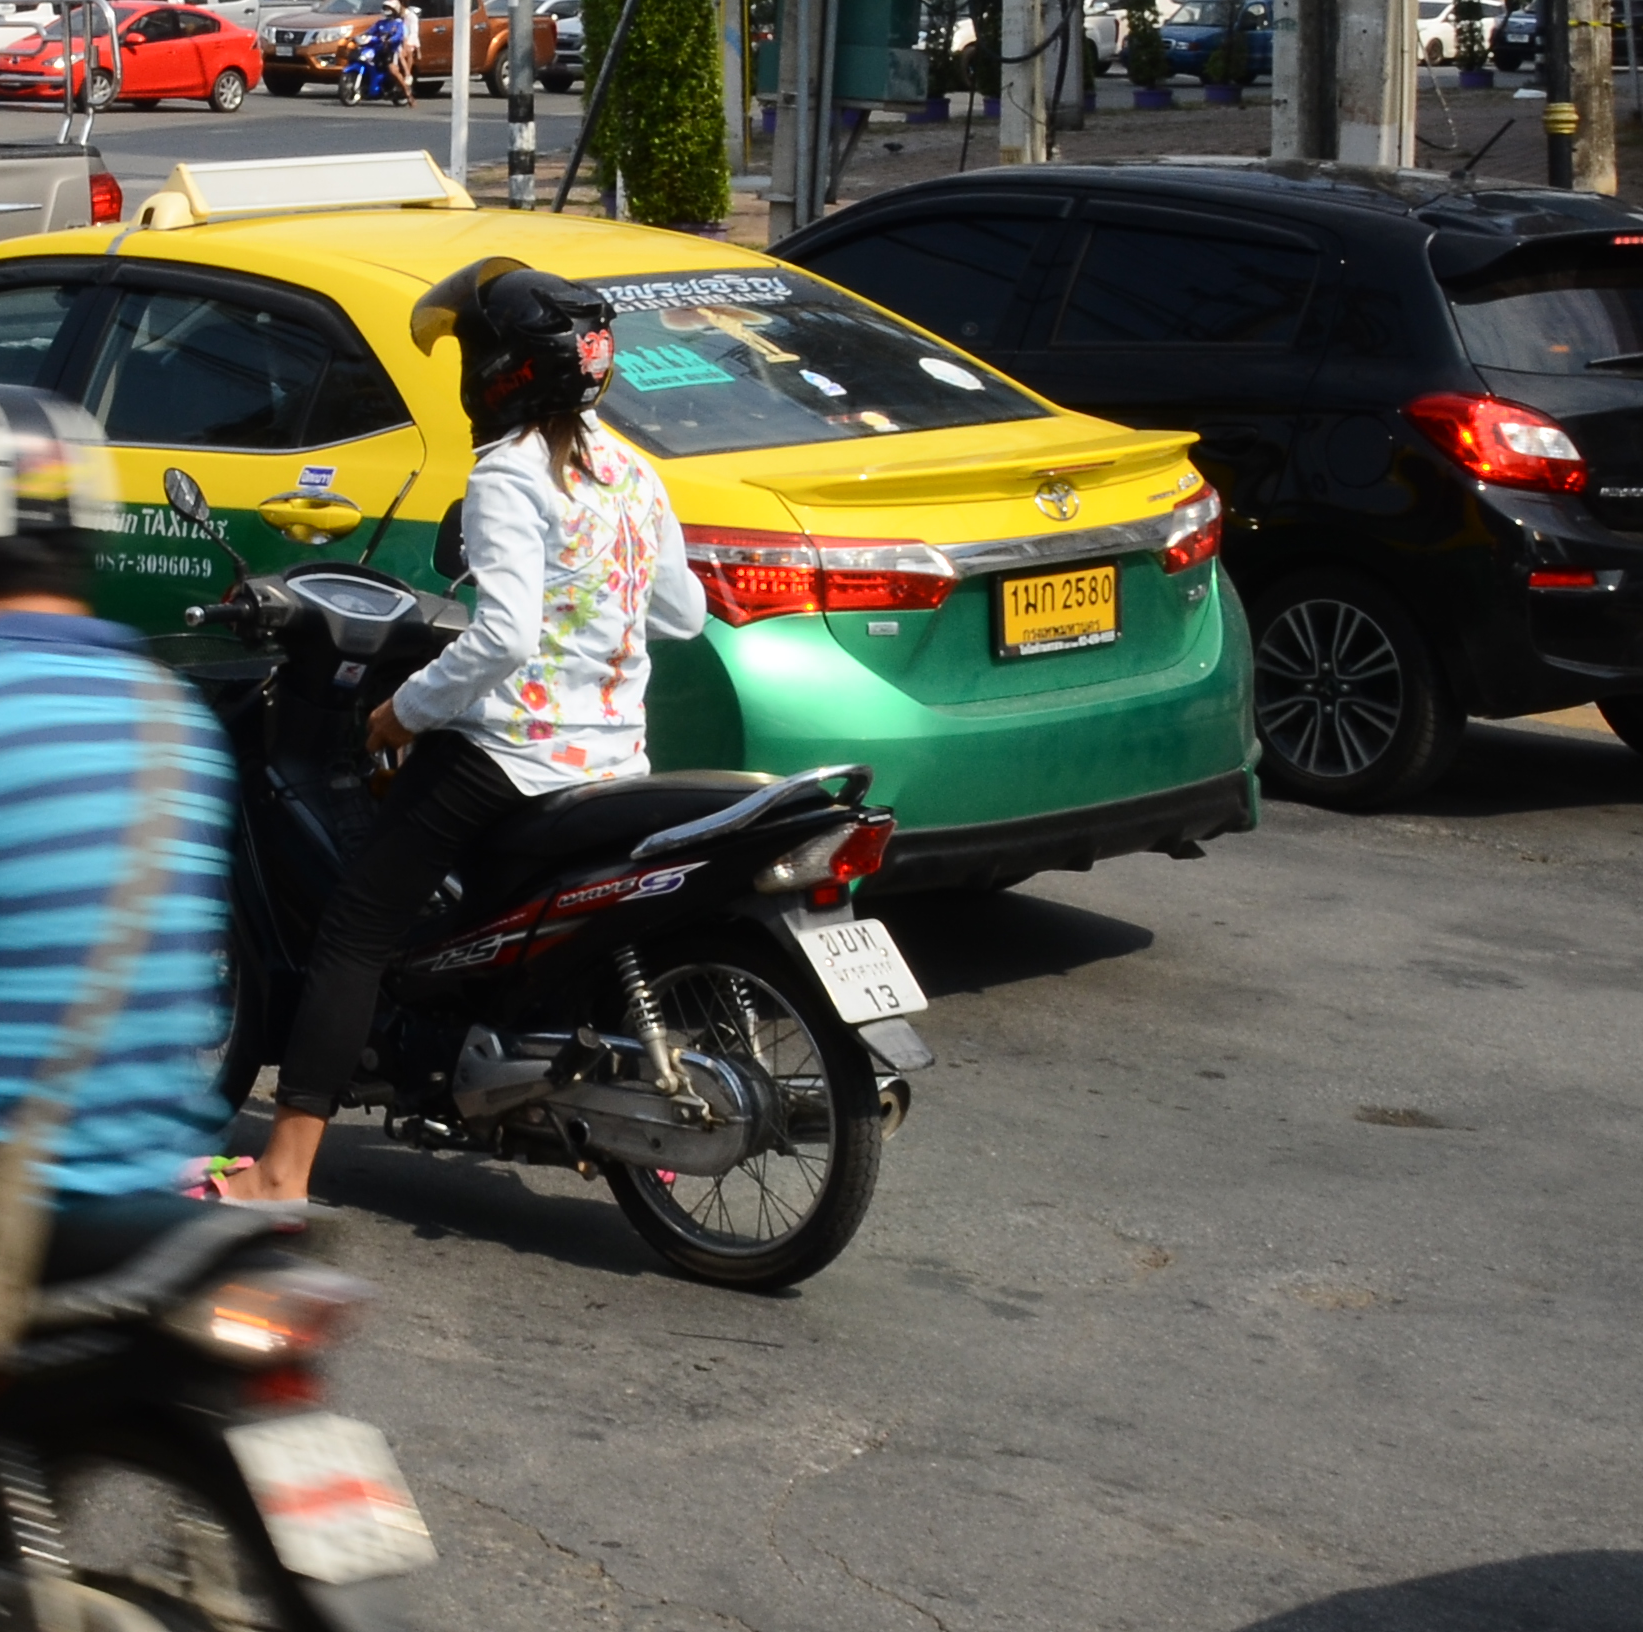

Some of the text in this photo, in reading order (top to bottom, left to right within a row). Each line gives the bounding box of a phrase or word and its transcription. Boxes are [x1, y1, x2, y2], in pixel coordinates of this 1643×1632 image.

[1061, 573, 1112, 610] 2580
[431, 933, 503, 972] 125
[863, 984, 900, 1013] 13
